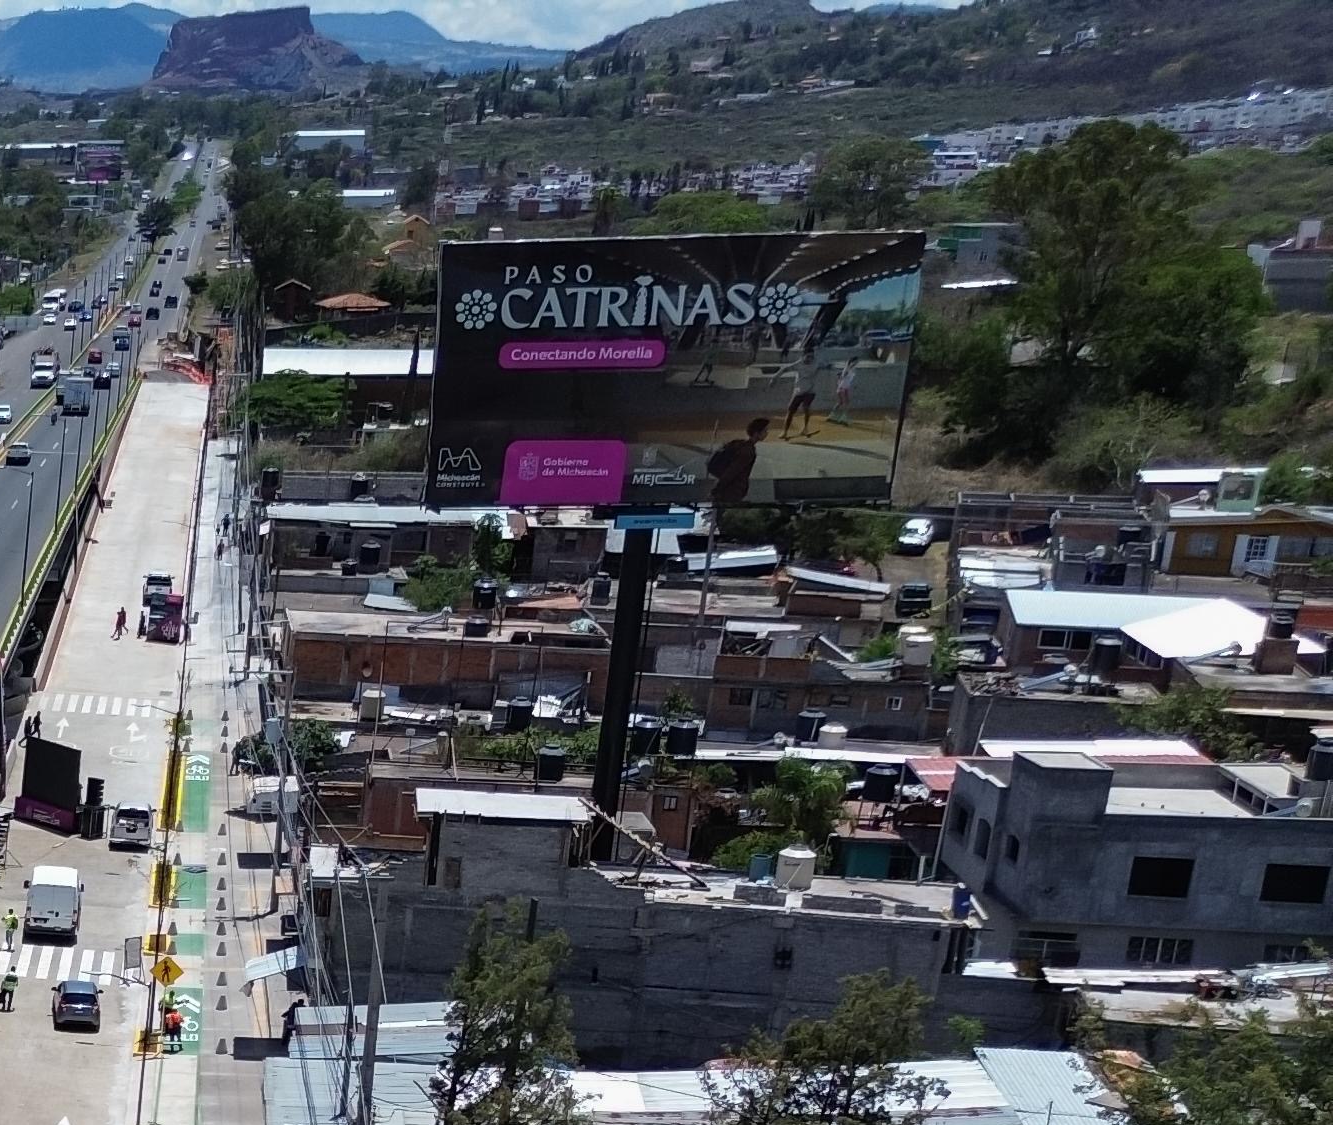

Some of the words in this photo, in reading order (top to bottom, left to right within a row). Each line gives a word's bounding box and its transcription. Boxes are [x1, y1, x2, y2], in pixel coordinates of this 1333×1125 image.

[504, 264, 593, 285] PASO
[500, 275, 756, 329] CATRINAS
[510, 348, 597, 362] Conectando
